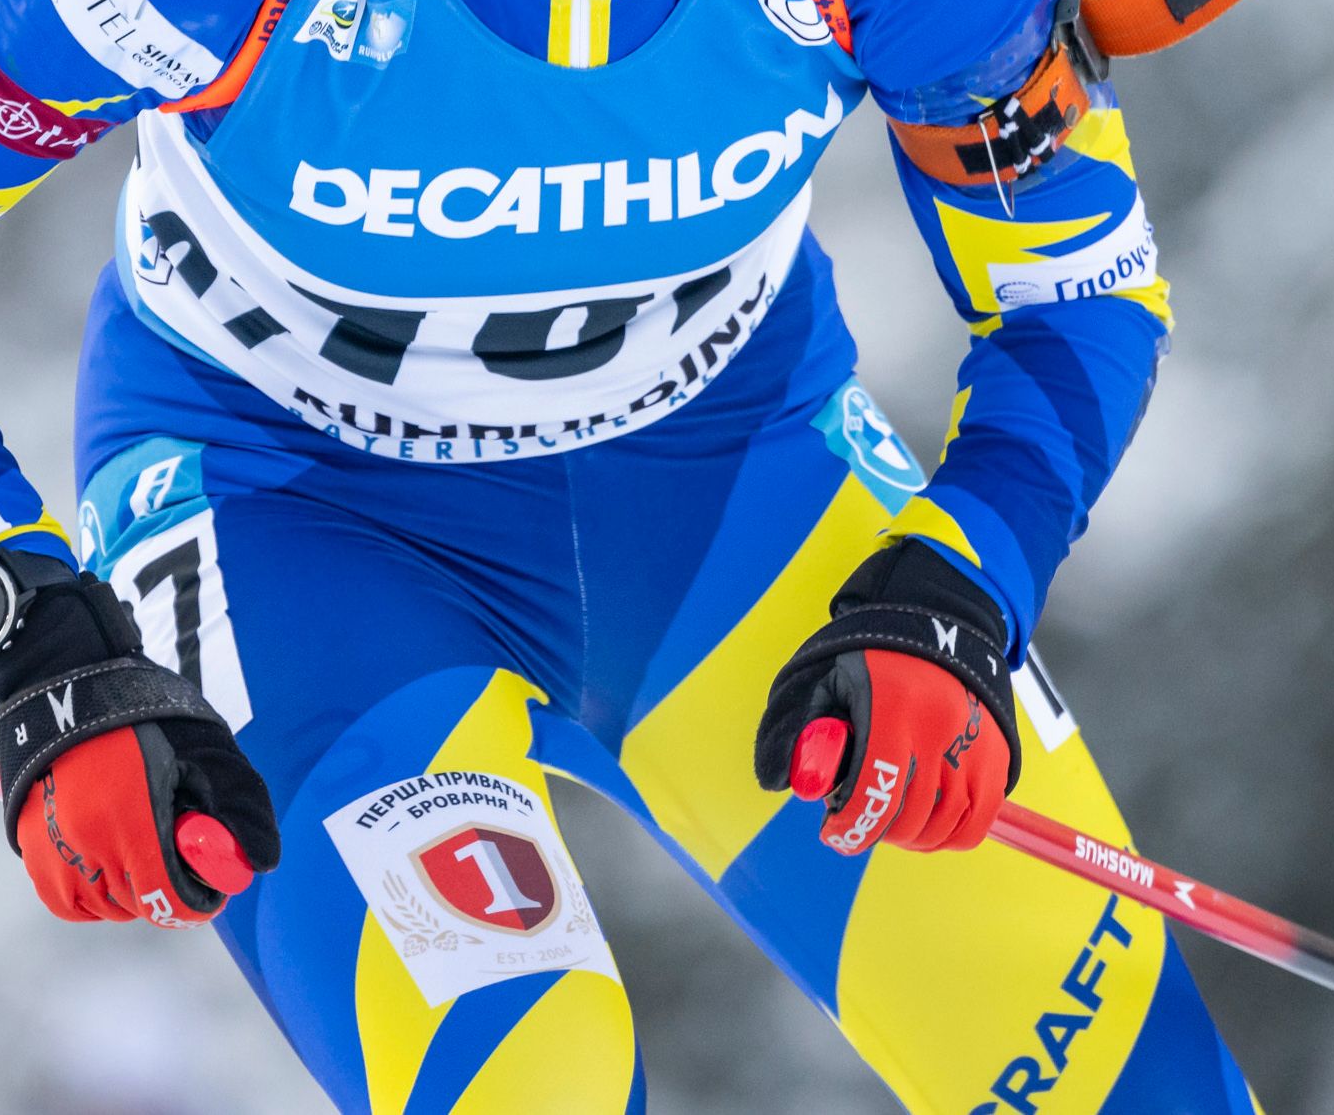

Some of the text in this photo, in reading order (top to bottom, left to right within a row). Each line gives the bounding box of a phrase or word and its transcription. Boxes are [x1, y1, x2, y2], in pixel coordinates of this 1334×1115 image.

[288, 80, 844, 239] DECATHLON
[355, 771, 535, 830] ПЕРША ПРИВАТНА
[406, 791, 509, 820] БРОВАРНЯ
[454, 839, 543, 915] 1
[1074, 835, 1155, 889] MADSHUS
